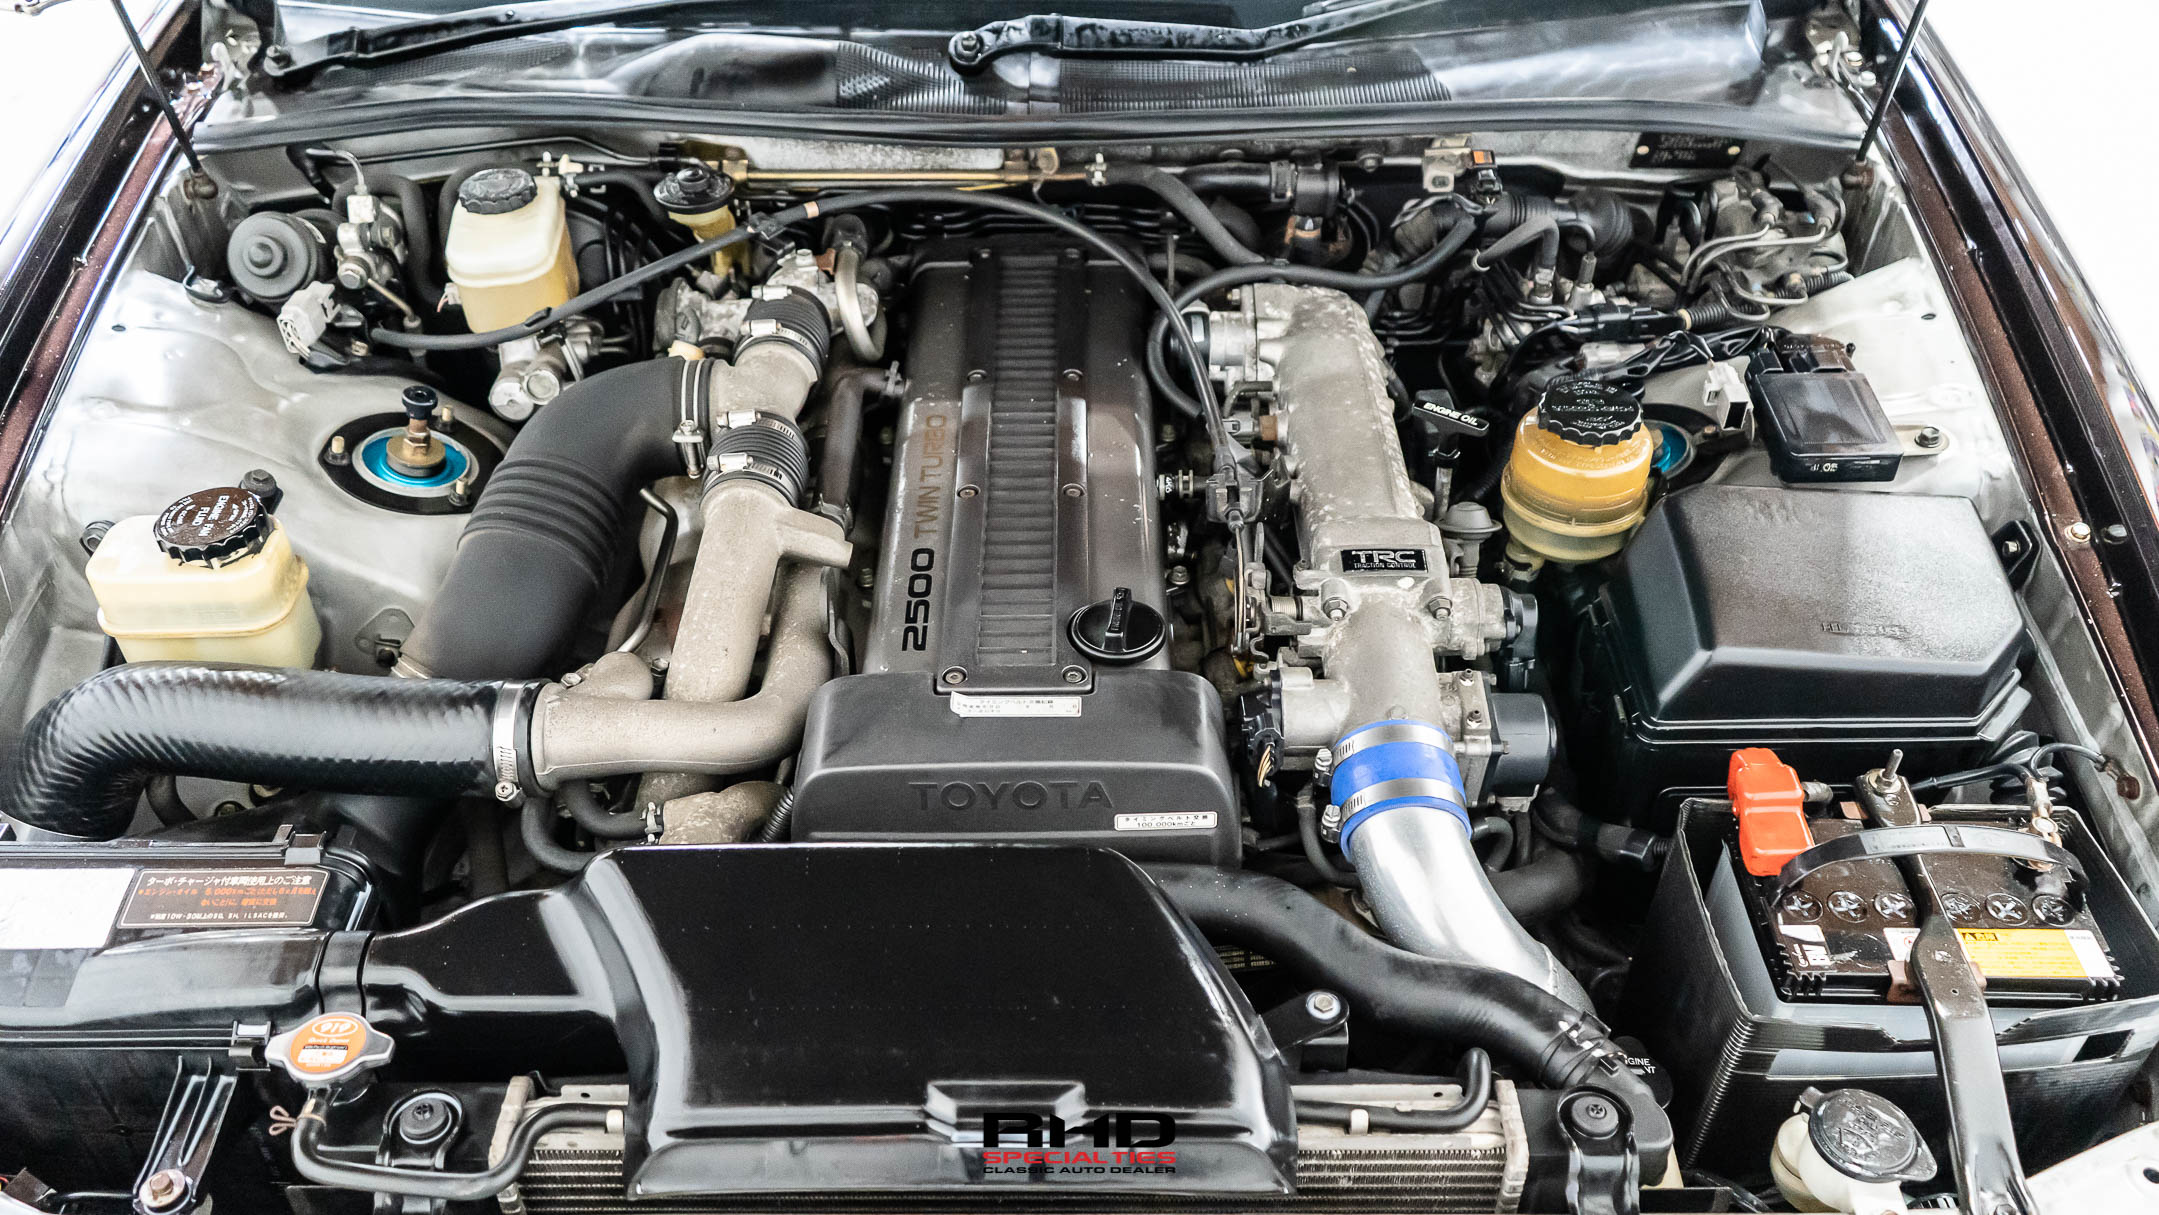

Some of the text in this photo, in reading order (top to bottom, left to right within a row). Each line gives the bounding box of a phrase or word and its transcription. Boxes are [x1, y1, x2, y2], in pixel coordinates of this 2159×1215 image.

[1423, 402, 1478, 426] ENGINE OIL
[192, 506, 211, 526] FLUID
[198, 495, 230, 537] ENGINE FAN
[902, 414, 947, 652] 2500 TWIN TURBO
[1351, 550, 1416, 565] TRC
[908, 780, 1114, 811] TOYOTA
